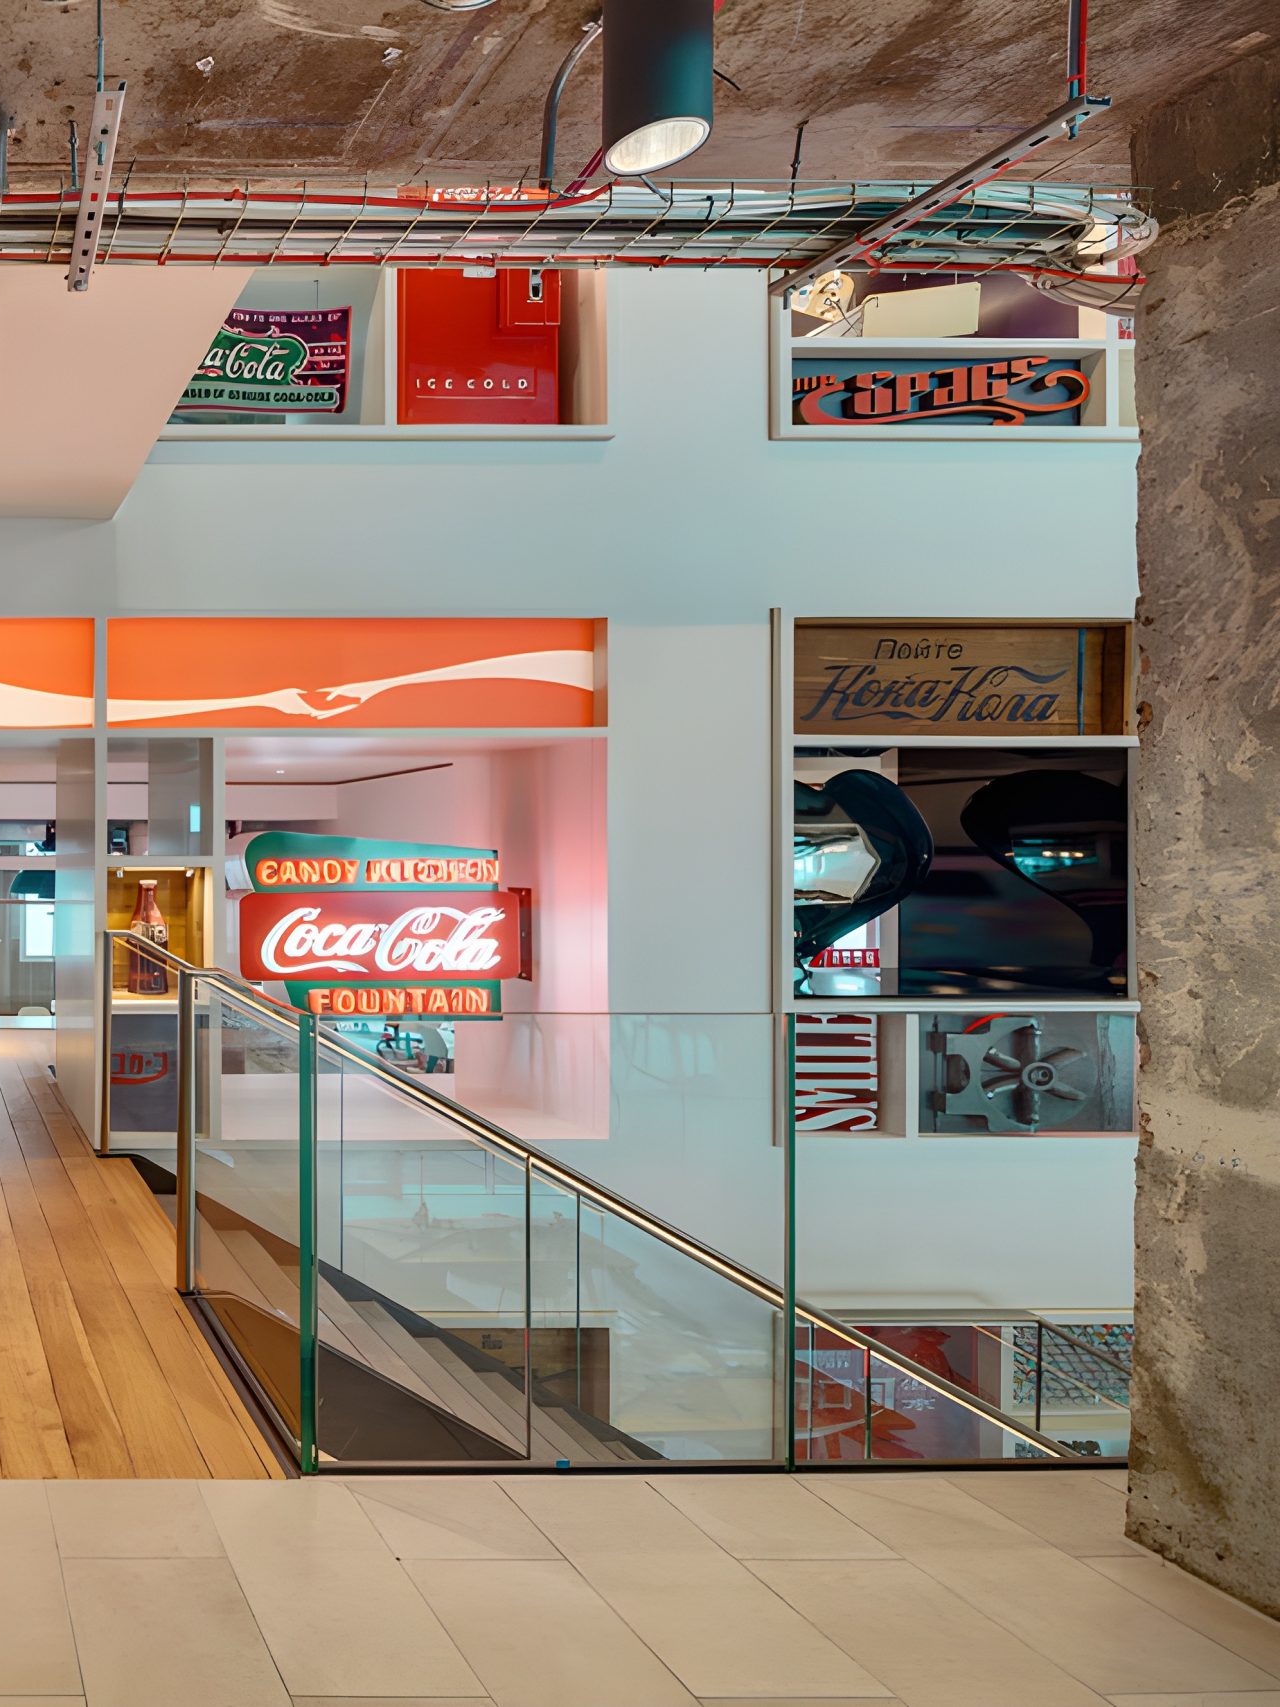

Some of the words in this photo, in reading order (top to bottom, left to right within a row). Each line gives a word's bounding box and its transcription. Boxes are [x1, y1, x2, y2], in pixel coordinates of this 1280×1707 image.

[466, 378, 528, 390] COLD
[260, 859, 360, 885] CANDY
[317, 987, 490, 1014] FOUNTAIN
